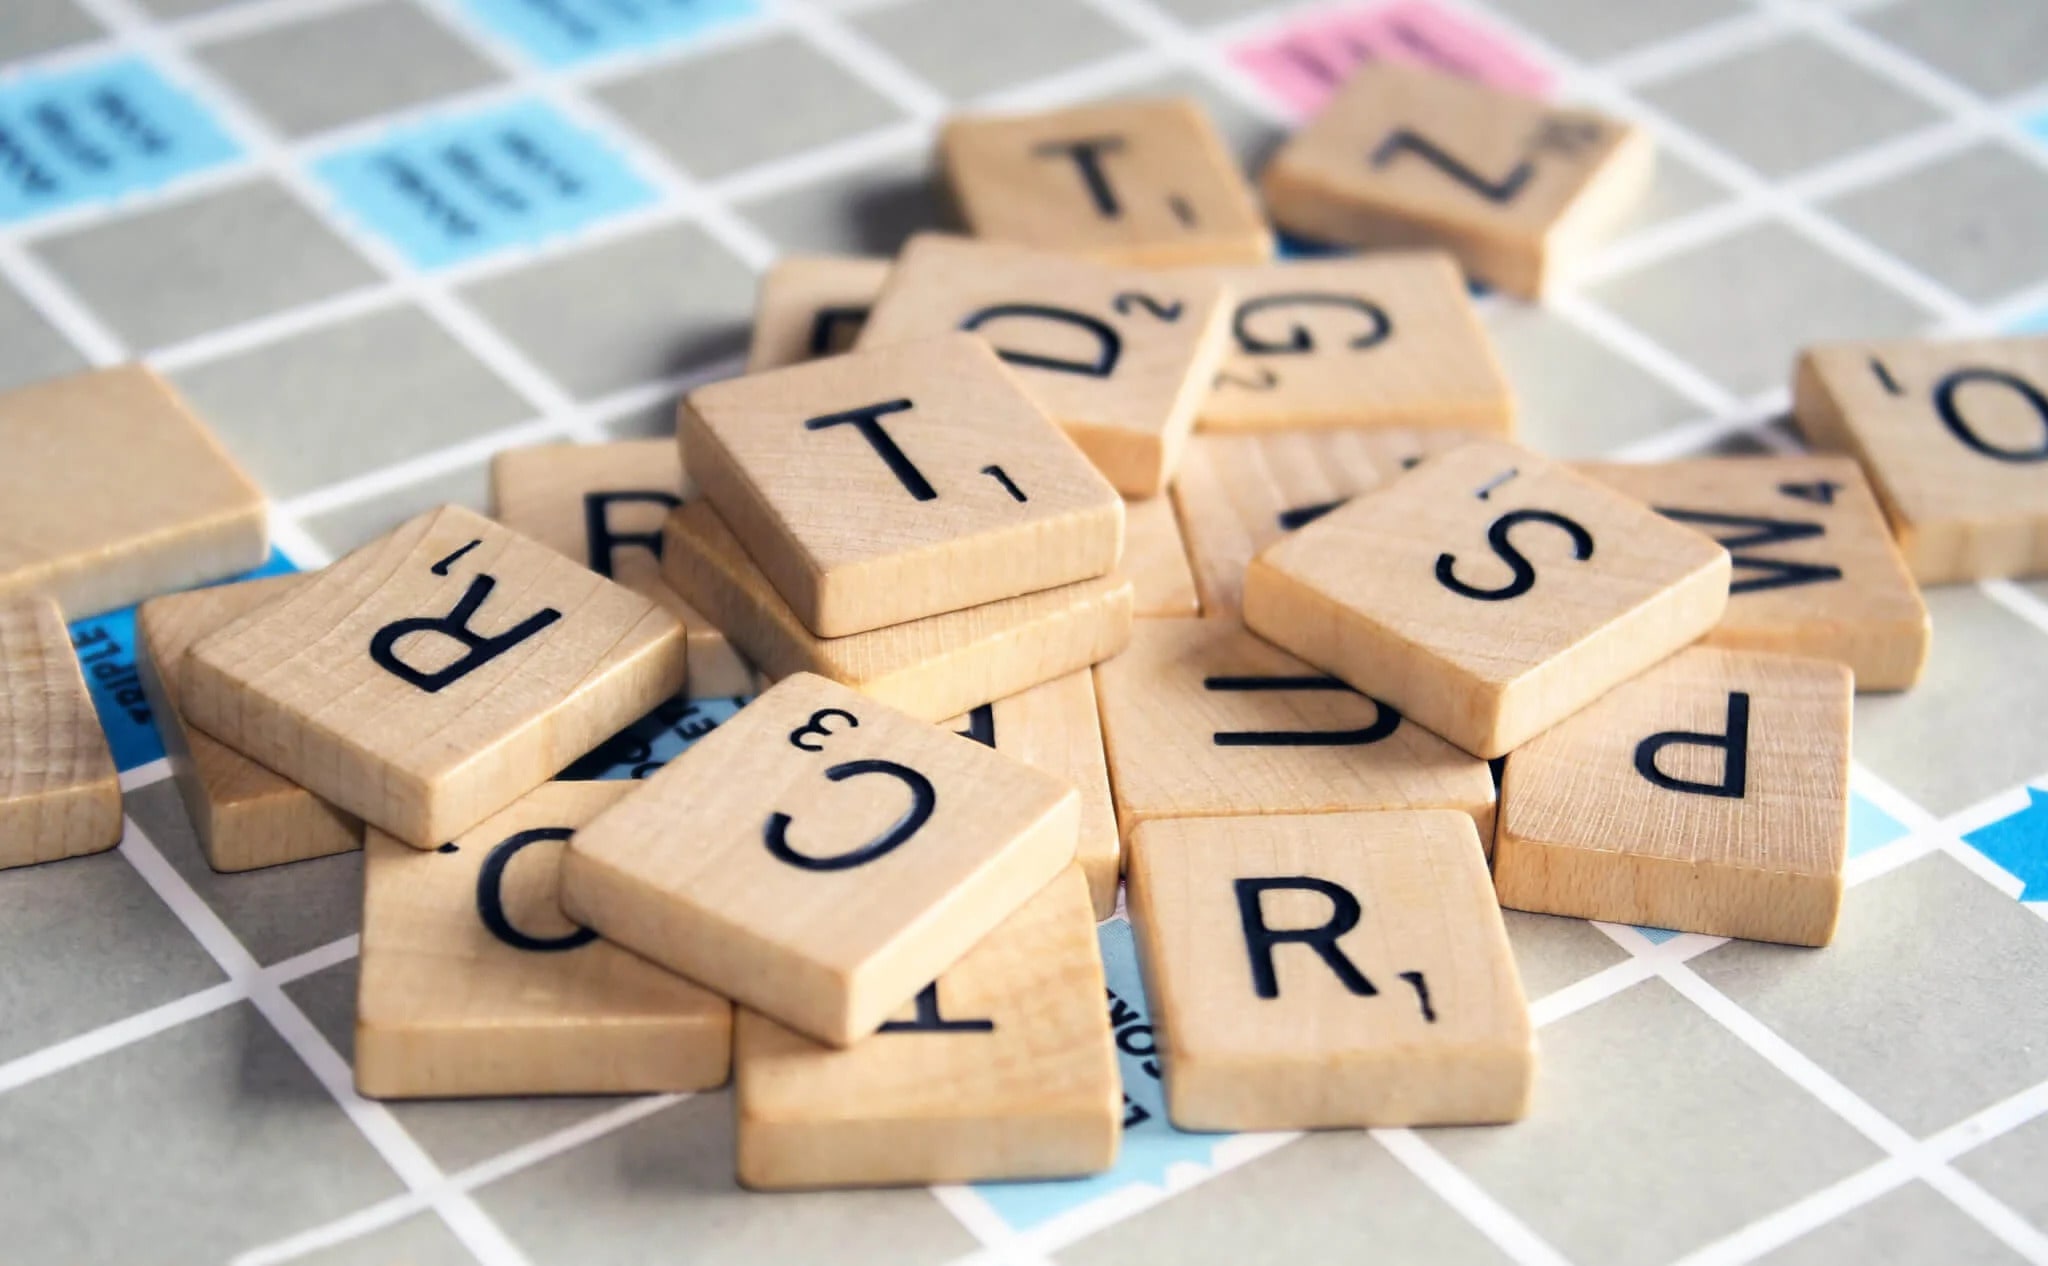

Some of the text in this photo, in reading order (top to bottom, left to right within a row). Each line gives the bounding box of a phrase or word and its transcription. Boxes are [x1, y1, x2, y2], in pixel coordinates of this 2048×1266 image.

[1033, 136, 1126, 221] T
[1370, 128, 1533, 206] Z
[961, 303, 1123, 379] D
[1231, 291, 1394, 356] G
[804, 397, 1029, 503] T 1
[1932, 368, 2048, 465] O
[1434, 468, 1596, 602] 1 S
[368, 538, 563, 694] R 1
[1202, 676, 1402, 746] U
[1633, 690, 1752, 800] P
[764, 707, 938, 873] C 3
[1233, 875, 1438, 1024] R 1
